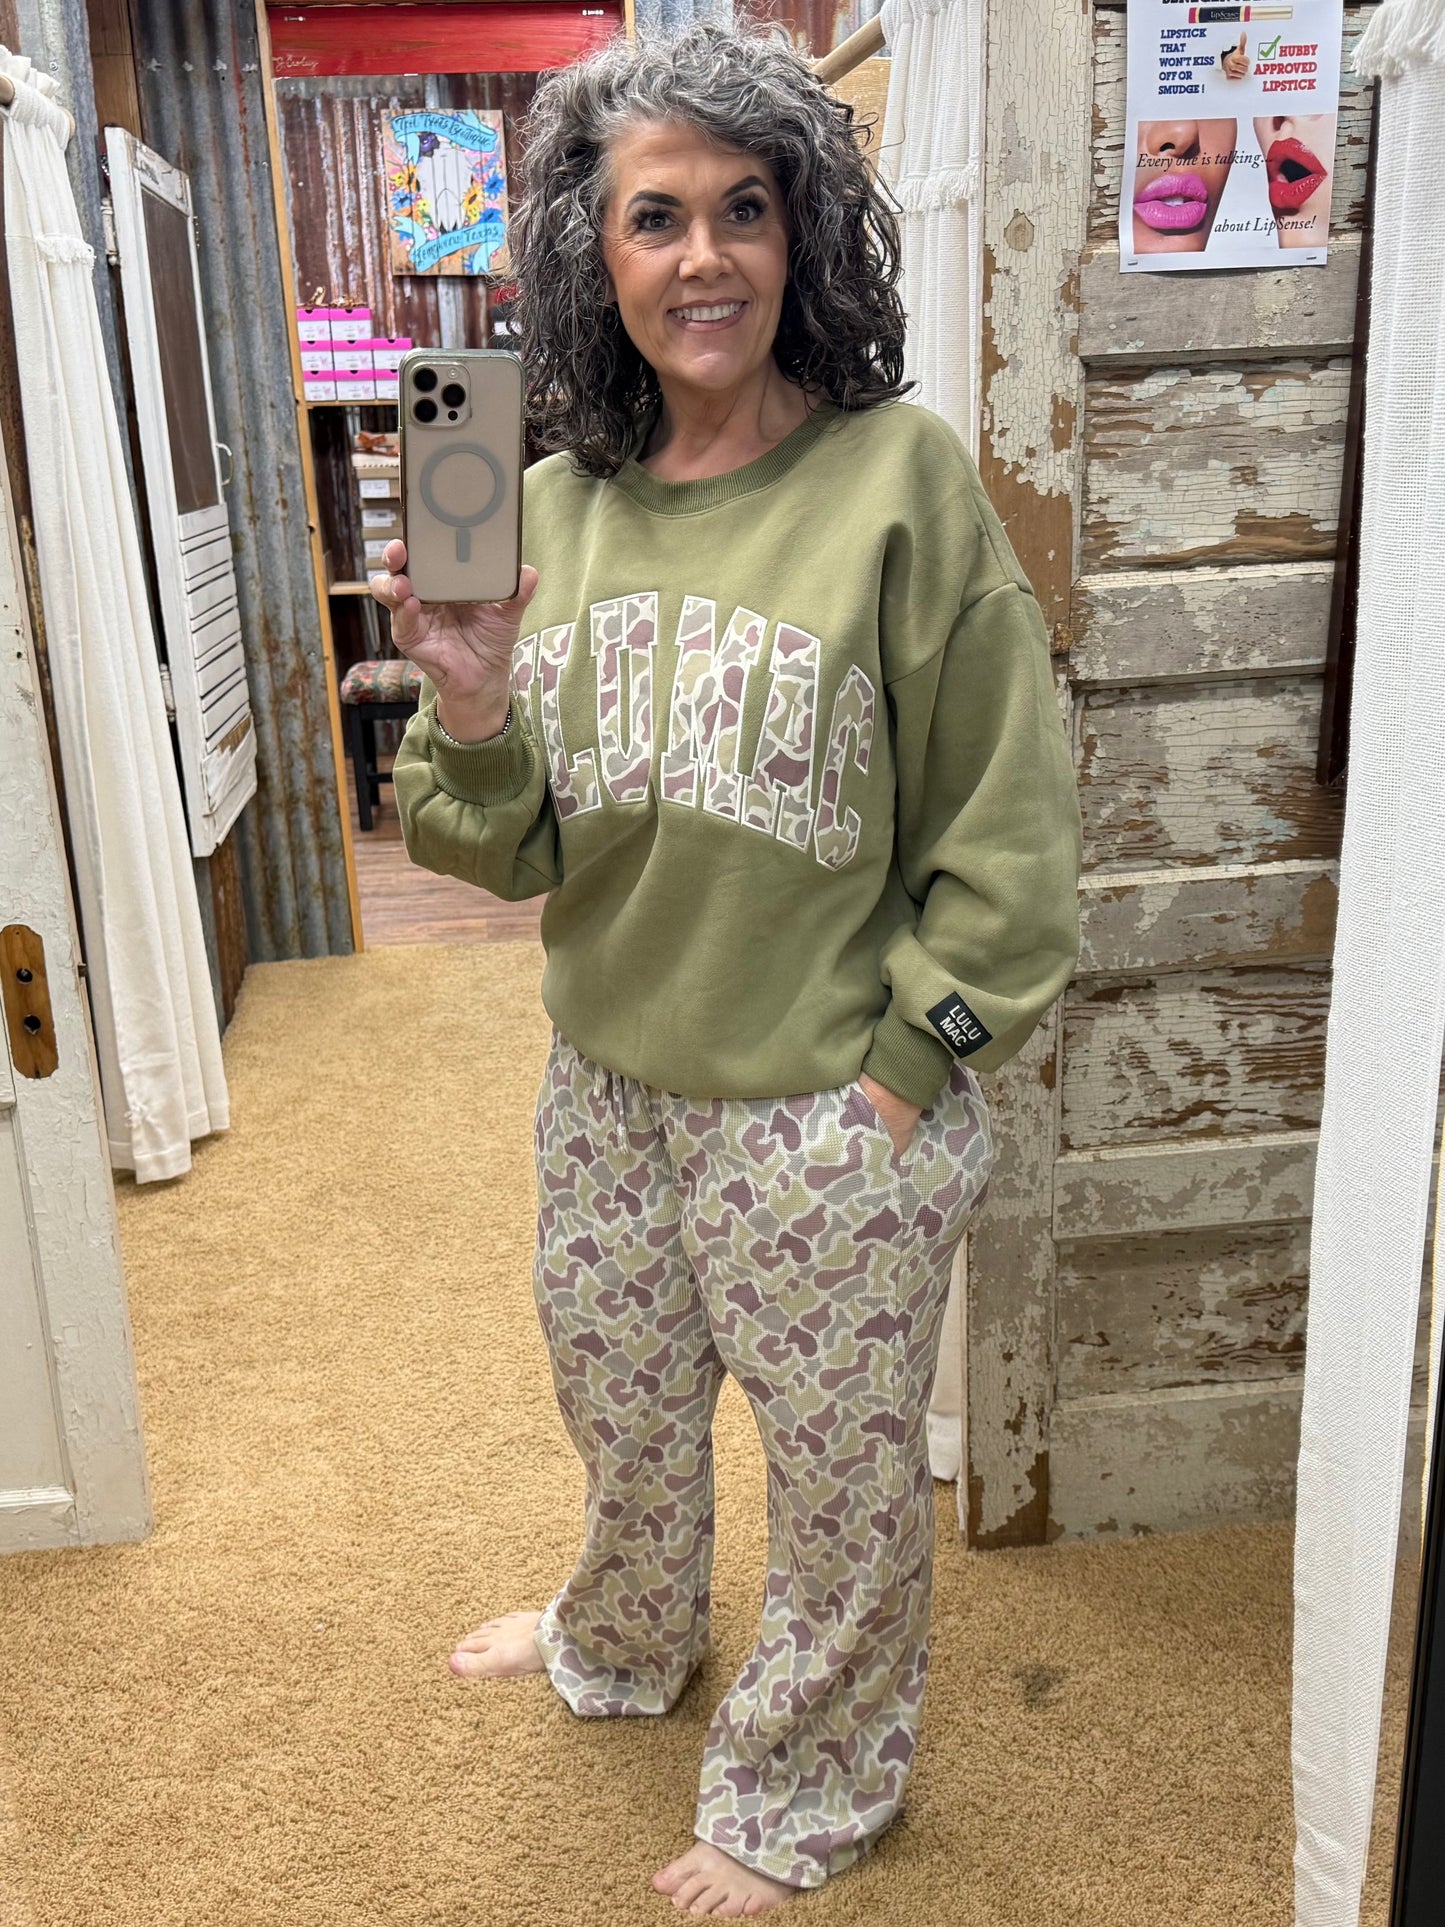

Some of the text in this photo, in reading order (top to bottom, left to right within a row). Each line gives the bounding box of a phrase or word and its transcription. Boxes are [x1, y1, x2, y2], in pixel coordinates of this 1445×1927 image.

[1160, 28, 1207, 39] LIPSTICK
[1160, 43, 1186, 53] THAT
[1279, 44, 1318, 58] HUBBY
[1159, 56, 1215, 67] WON'T KISS
[1254, 62, 1318, 75] APPROVED
[1159, 71, 1192, 80] OFF OR
[1158, 85, 1199, 95] SMUDGE
[1263, 79, 1317, 92] LIPSTICK
[1136, 153, 1173, 172] Every
[1176, 157, 1198, 167] one
[1202, 152, 1211, 166] is
[1214, 215, 1317, 236] about LipSense!
[949, 1004, 981, 1040] LULU
[939, 1016, 967, 1047] MAC
